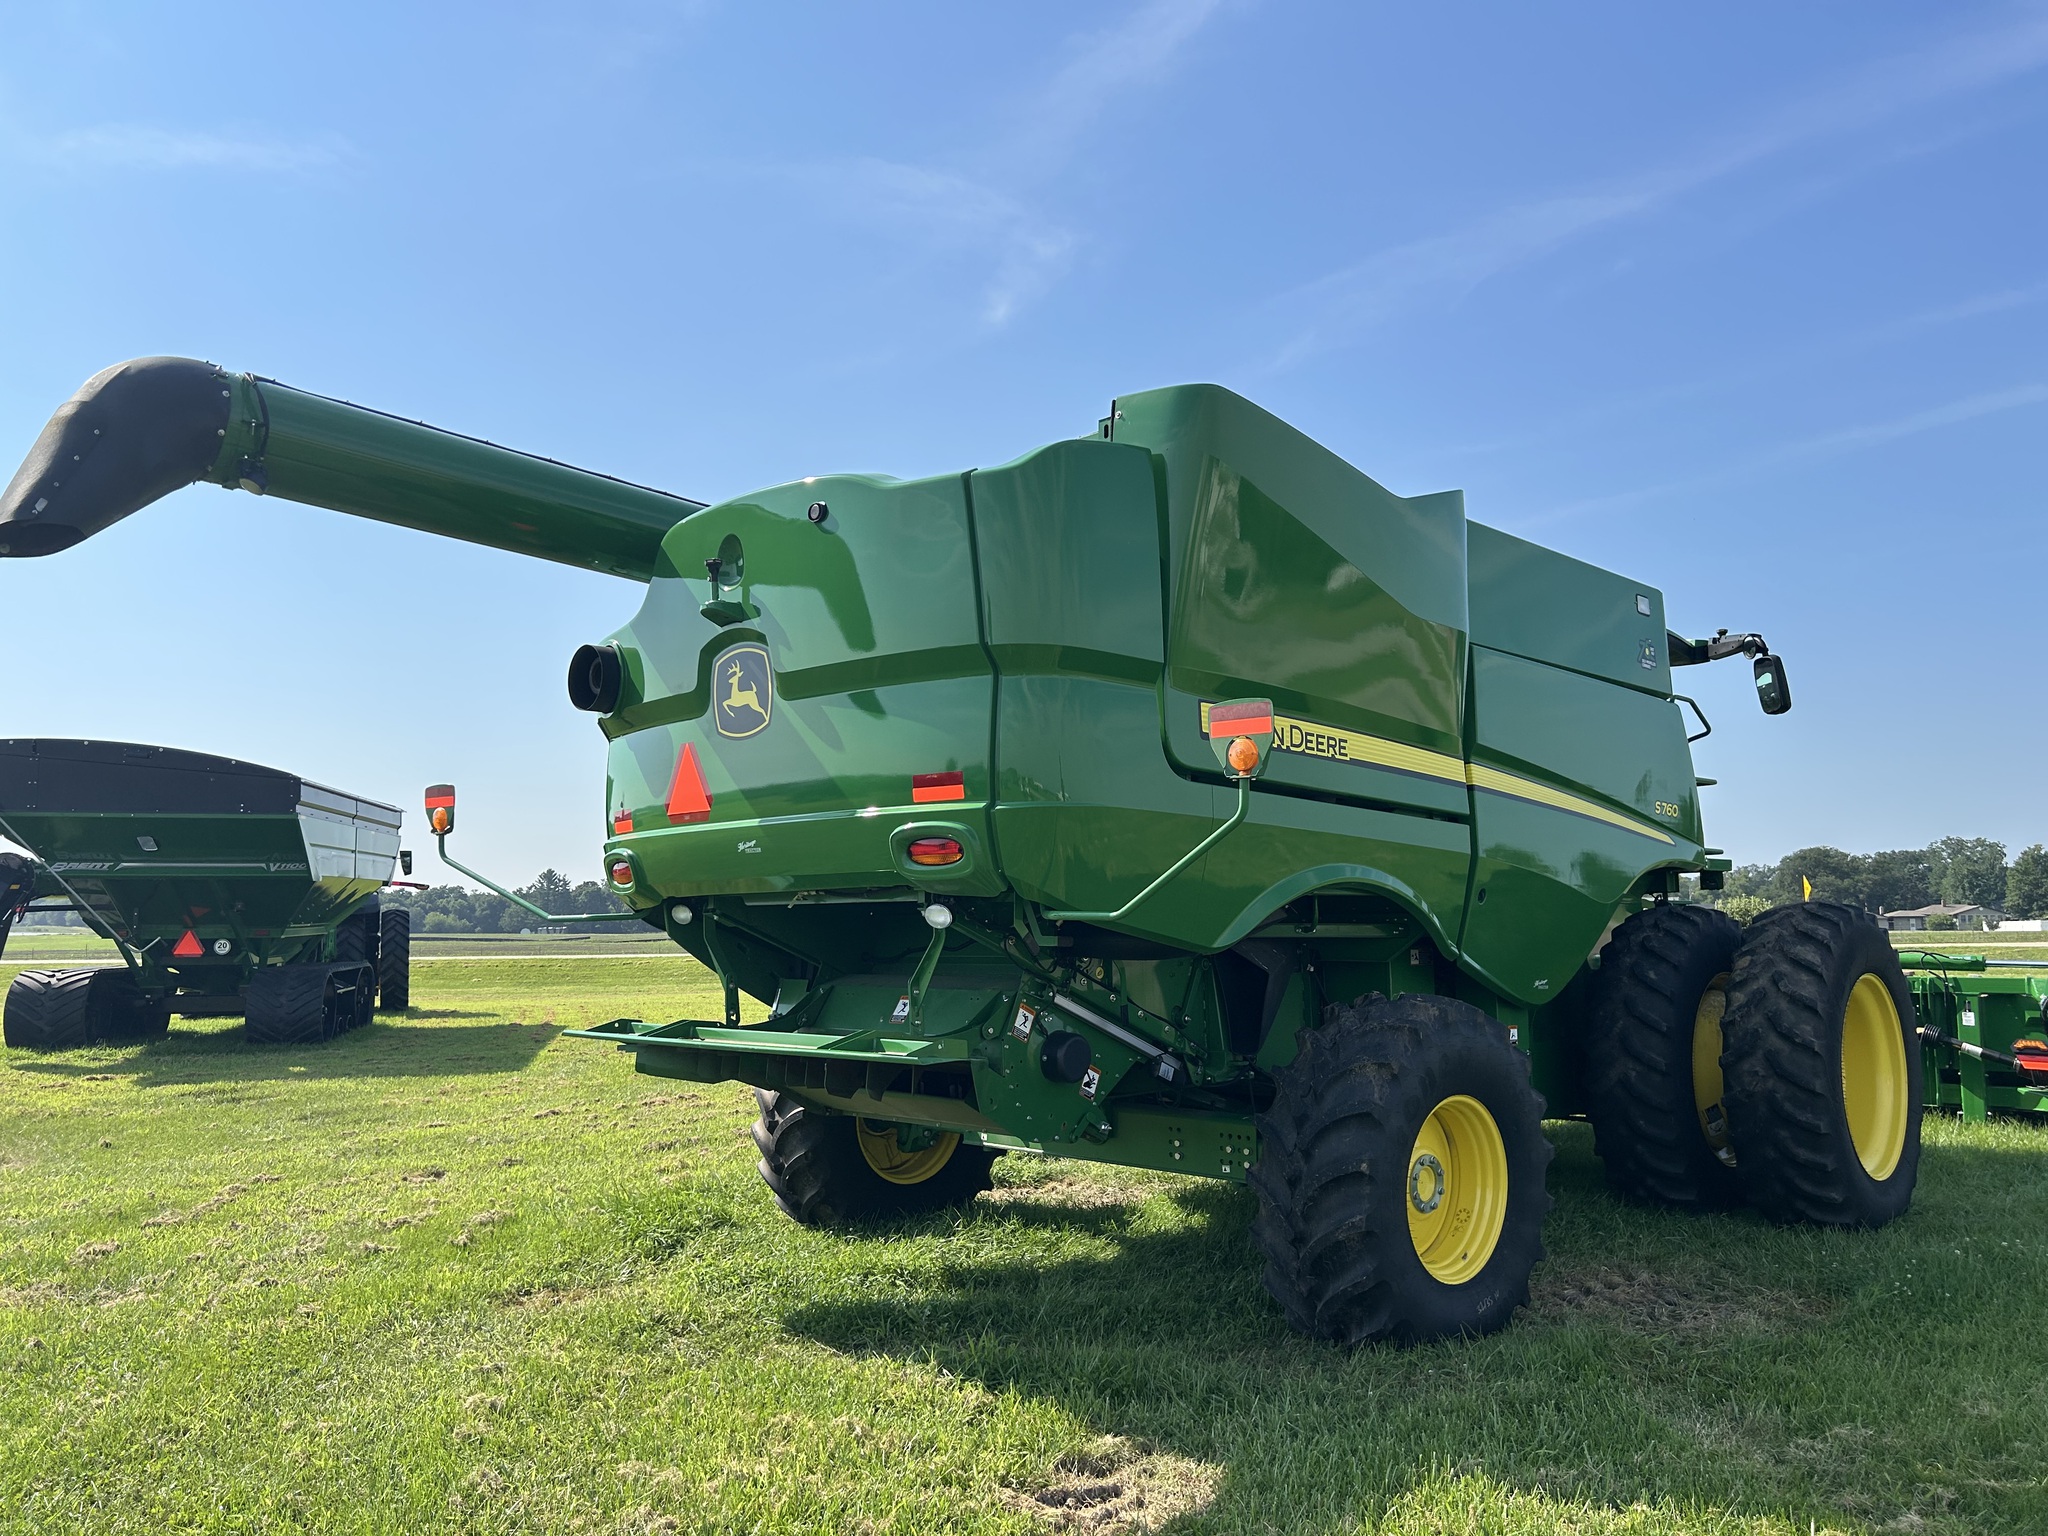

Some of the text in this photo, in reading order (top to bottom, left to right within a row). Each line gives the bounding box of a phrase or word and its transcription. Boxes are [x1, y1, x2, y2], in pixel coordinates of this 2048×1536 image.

[1289, 724, 1349, 758] DEERE
[1655, 800, 1679, 818] S760
[46, 862, 114, 872] BRENT
[269, 862, 307, 872] V1100
[217, 941, 229, 949] 20
